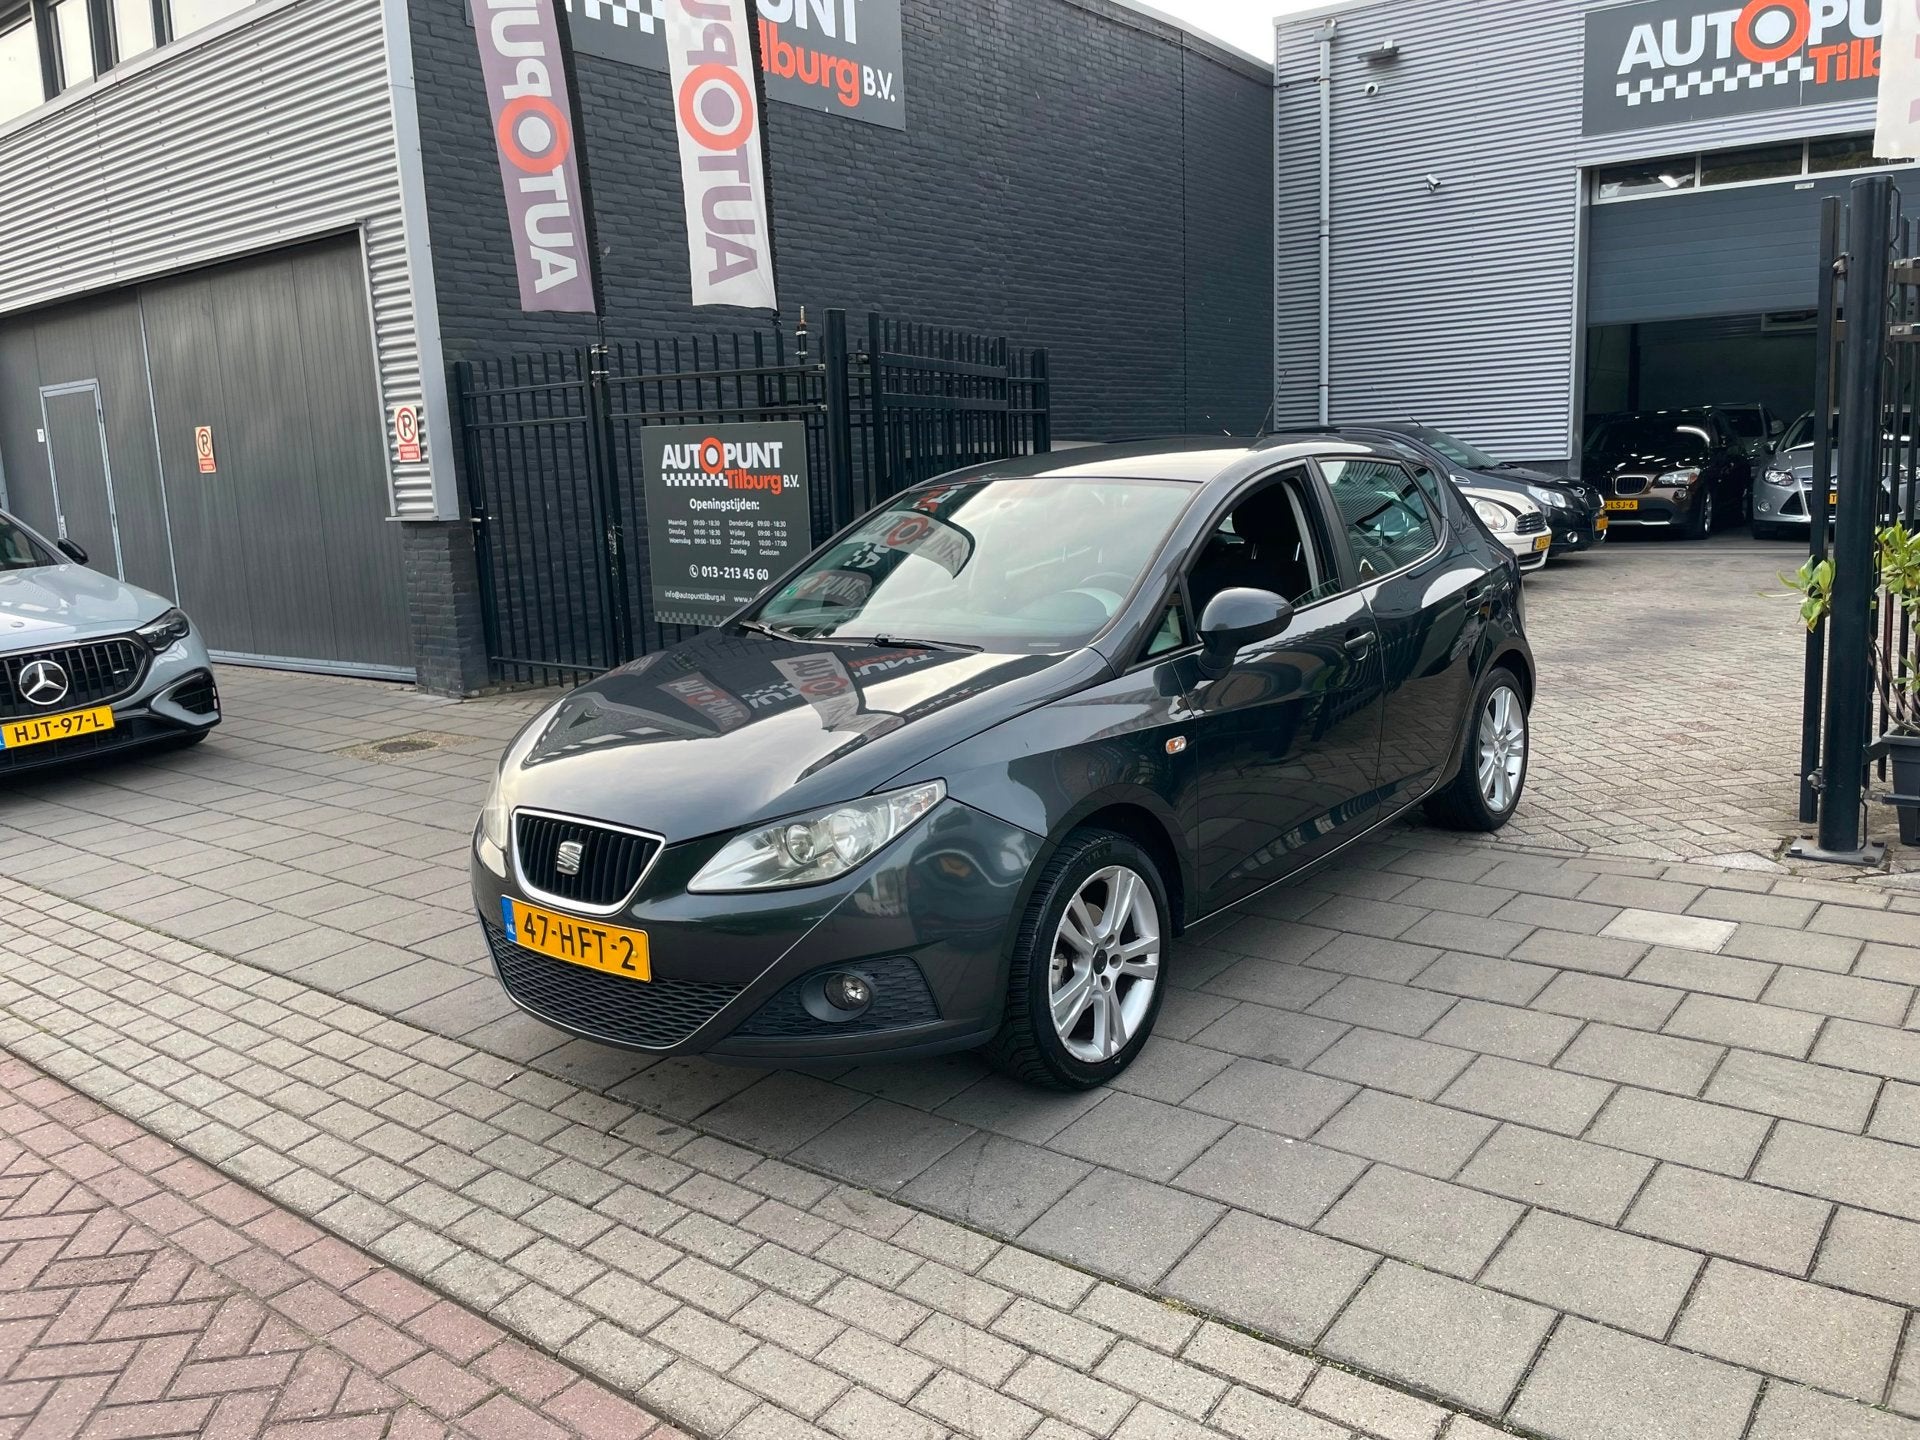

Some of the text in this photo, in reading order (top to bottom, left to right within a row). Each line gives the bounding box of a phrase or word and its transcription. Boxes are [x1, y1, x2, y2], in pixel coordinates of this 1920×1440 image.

[1617, 0, 1883, 75] AUTOPU
[758, 17, 896, 107] lburg B.V.
[1809, 39, 1881, 84] Tilb
[661, 436, 783, 475] AUTOPUNT
[725, 468, 800, 495] Tilburg B.V.
[689, 498, 760, 512] Openingstijden:
[668, 519, 687, 527] Maandag
[668, 528, 686, 536] Dinsdag
[728, 520, 754, 528] Donderdag
[729, 529, 746, 537] Vrijdag
[730, 548, 780, 556] Zondag Gesloten
[743, 567, 755, 580] 45
[756, 569, 769, 580] 60
[14, 712, 105, 743] HJT-97-L
[524, 912, 636, 971] 47-HFT-2
